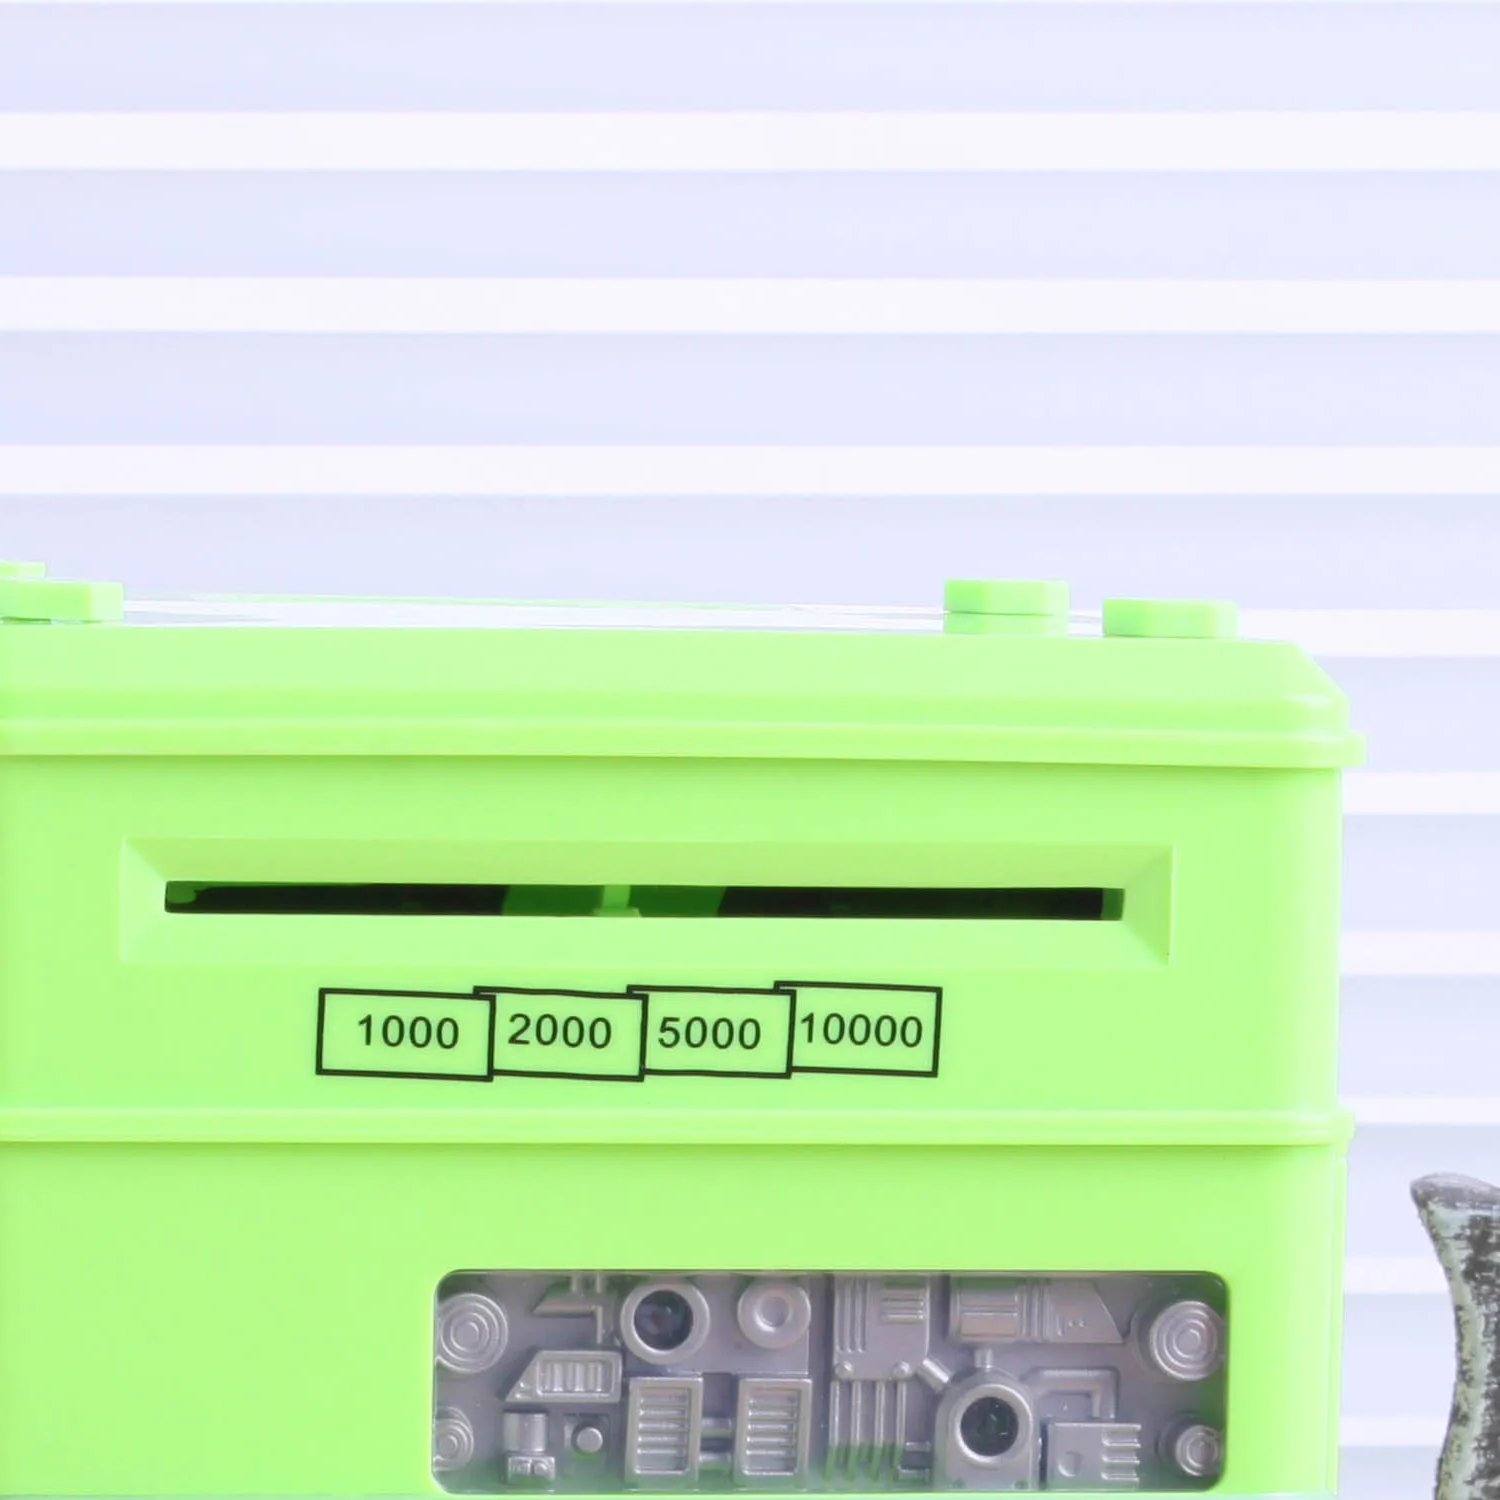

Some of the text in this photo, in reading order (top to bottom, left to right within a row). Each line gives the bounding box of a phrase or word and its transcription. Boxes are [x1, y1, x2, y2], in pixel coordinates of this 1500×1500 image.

[358, 1012, 923, 1050] 1000 2000 5000 10000
